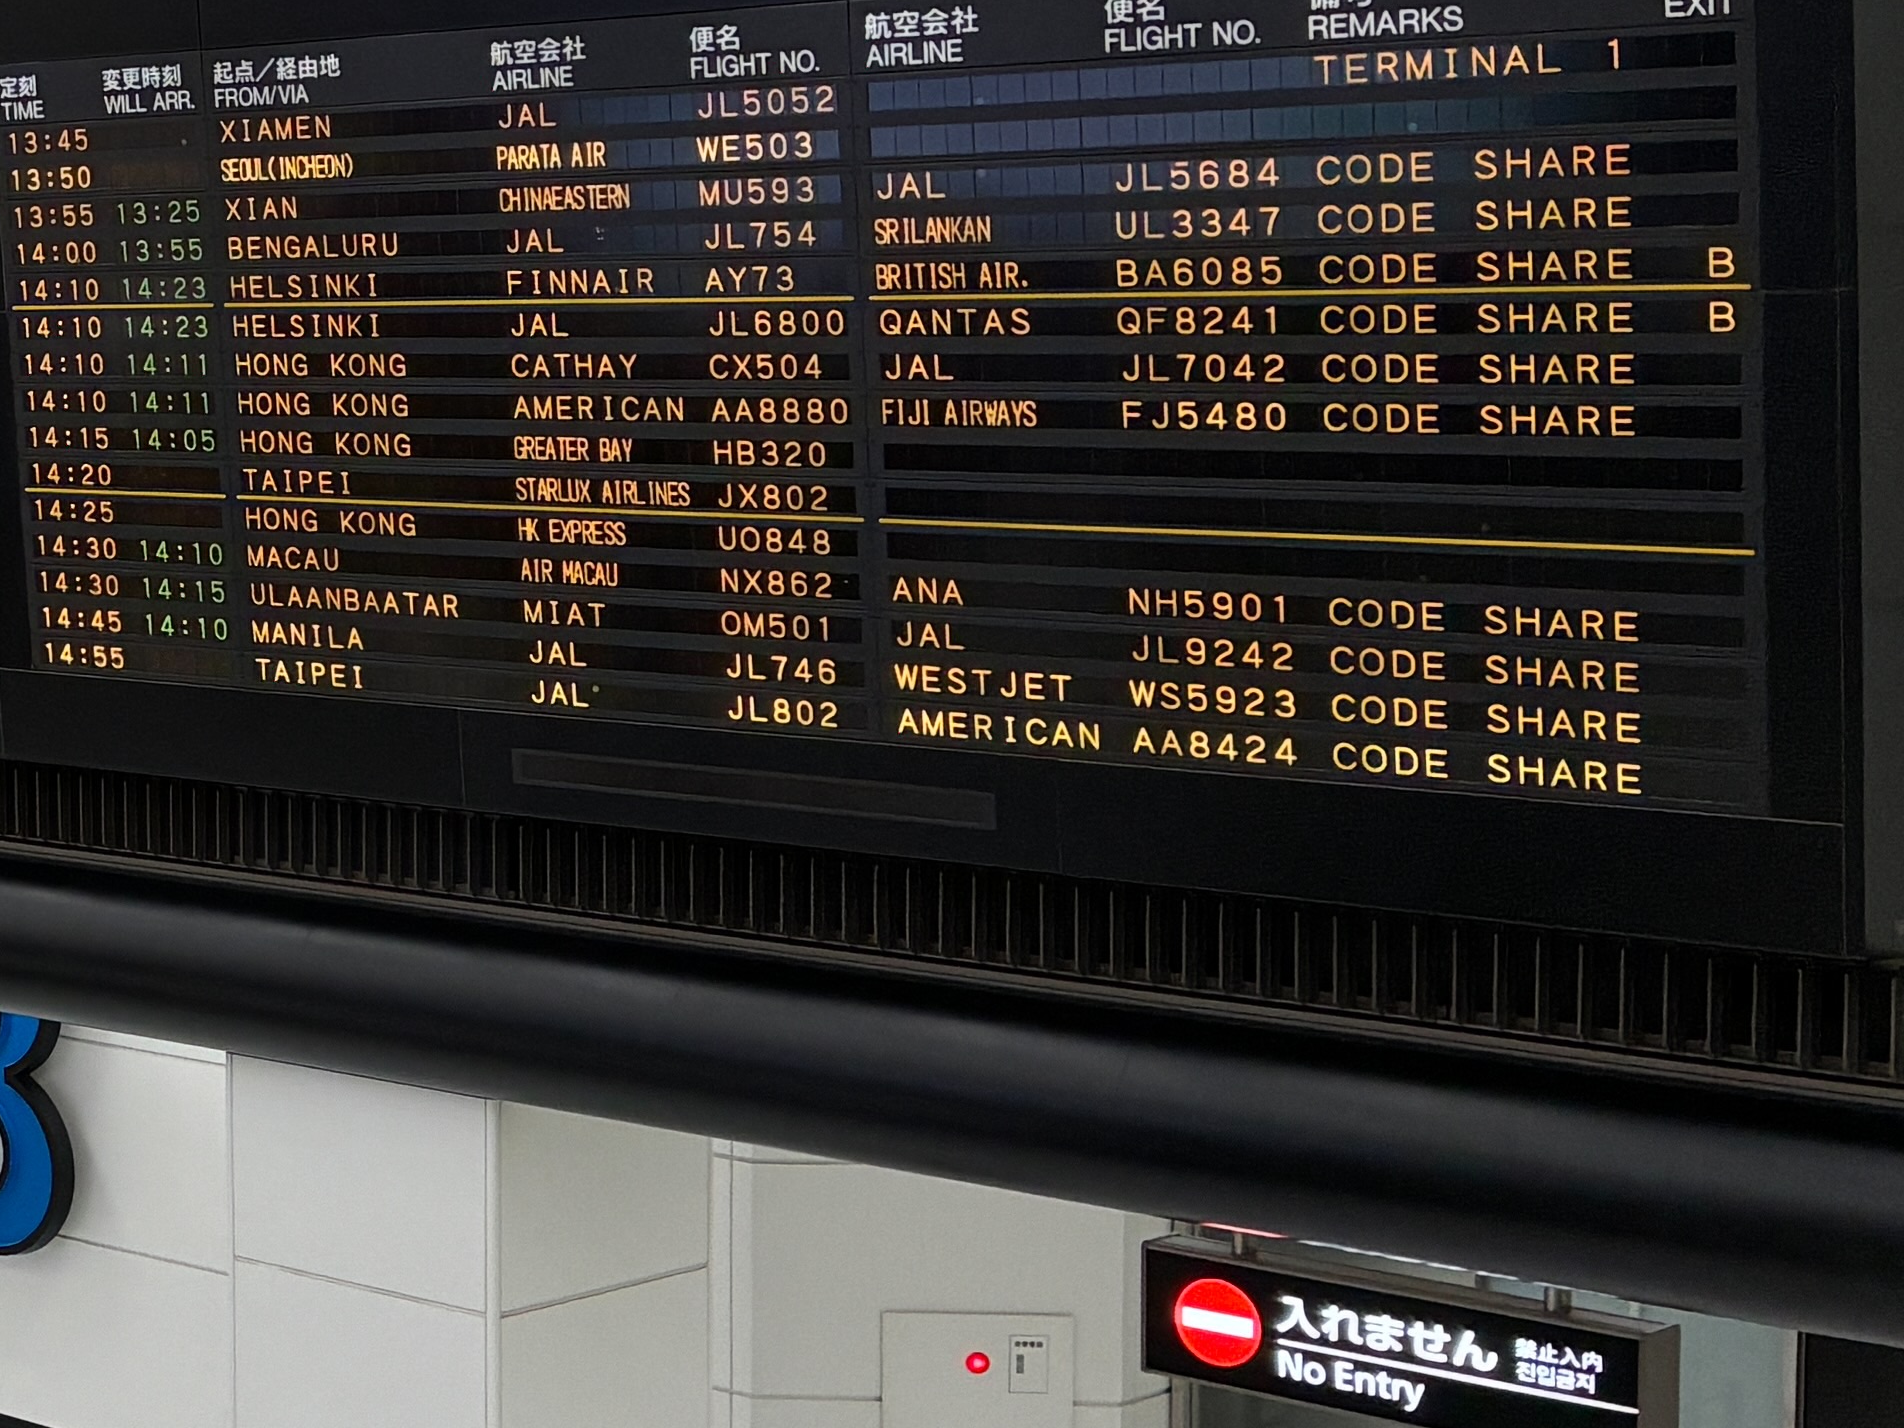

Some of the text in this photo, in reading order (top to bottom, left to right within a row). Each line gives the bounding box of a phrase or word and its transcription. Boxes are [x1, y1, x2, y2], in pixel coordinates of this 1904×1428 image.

[0, 76, 37, 99] 定刻
[102, 64, 181, 91] 変更時刻
[490, 36, 587, 64] 航空会社
[689, 25, 740, 52] 便名
[1, 98, 45, 122] TIME
[103, 91, 150, 115] WILL
[154, 87, 195, 112] ARR.
[214, 83, 310, 109] FROM/VIA
[493, 63, 574, 91] AIRLINE
[690, 52, 773, 80] FLIGHT
[777, 49, 820, 75] NO.
[1308, 6, 1464, 39] REMARKS
[8, 39, 1621, 153] 13:45 XIAMEN JAL JL5052 TERMINAL 1
[14, 195, 1632, 265] 14:00 13:55 BENGALURU JAL JL754 SRILANKAN UL3347 CODE SHARE
[21, 301, 1736, 341] 14:10 14:23 HELSINKI JAL JL6800 QANTAS QF8241 CODE SHARE B
[27, 388, 1636, 437] 14:10 14:11 HONG KONG AMERICAN AA8880 FIJI AIRWAYS FJ5480 CODE SHARE
[1276, 1294, 1498, 1372] 入れません
[1515, 1338, 1603, 1373] 禁止入内
[1277, 1350, 1425, 1412] No Entry
[1516, 1361, 1597, 1394] 진입금지
